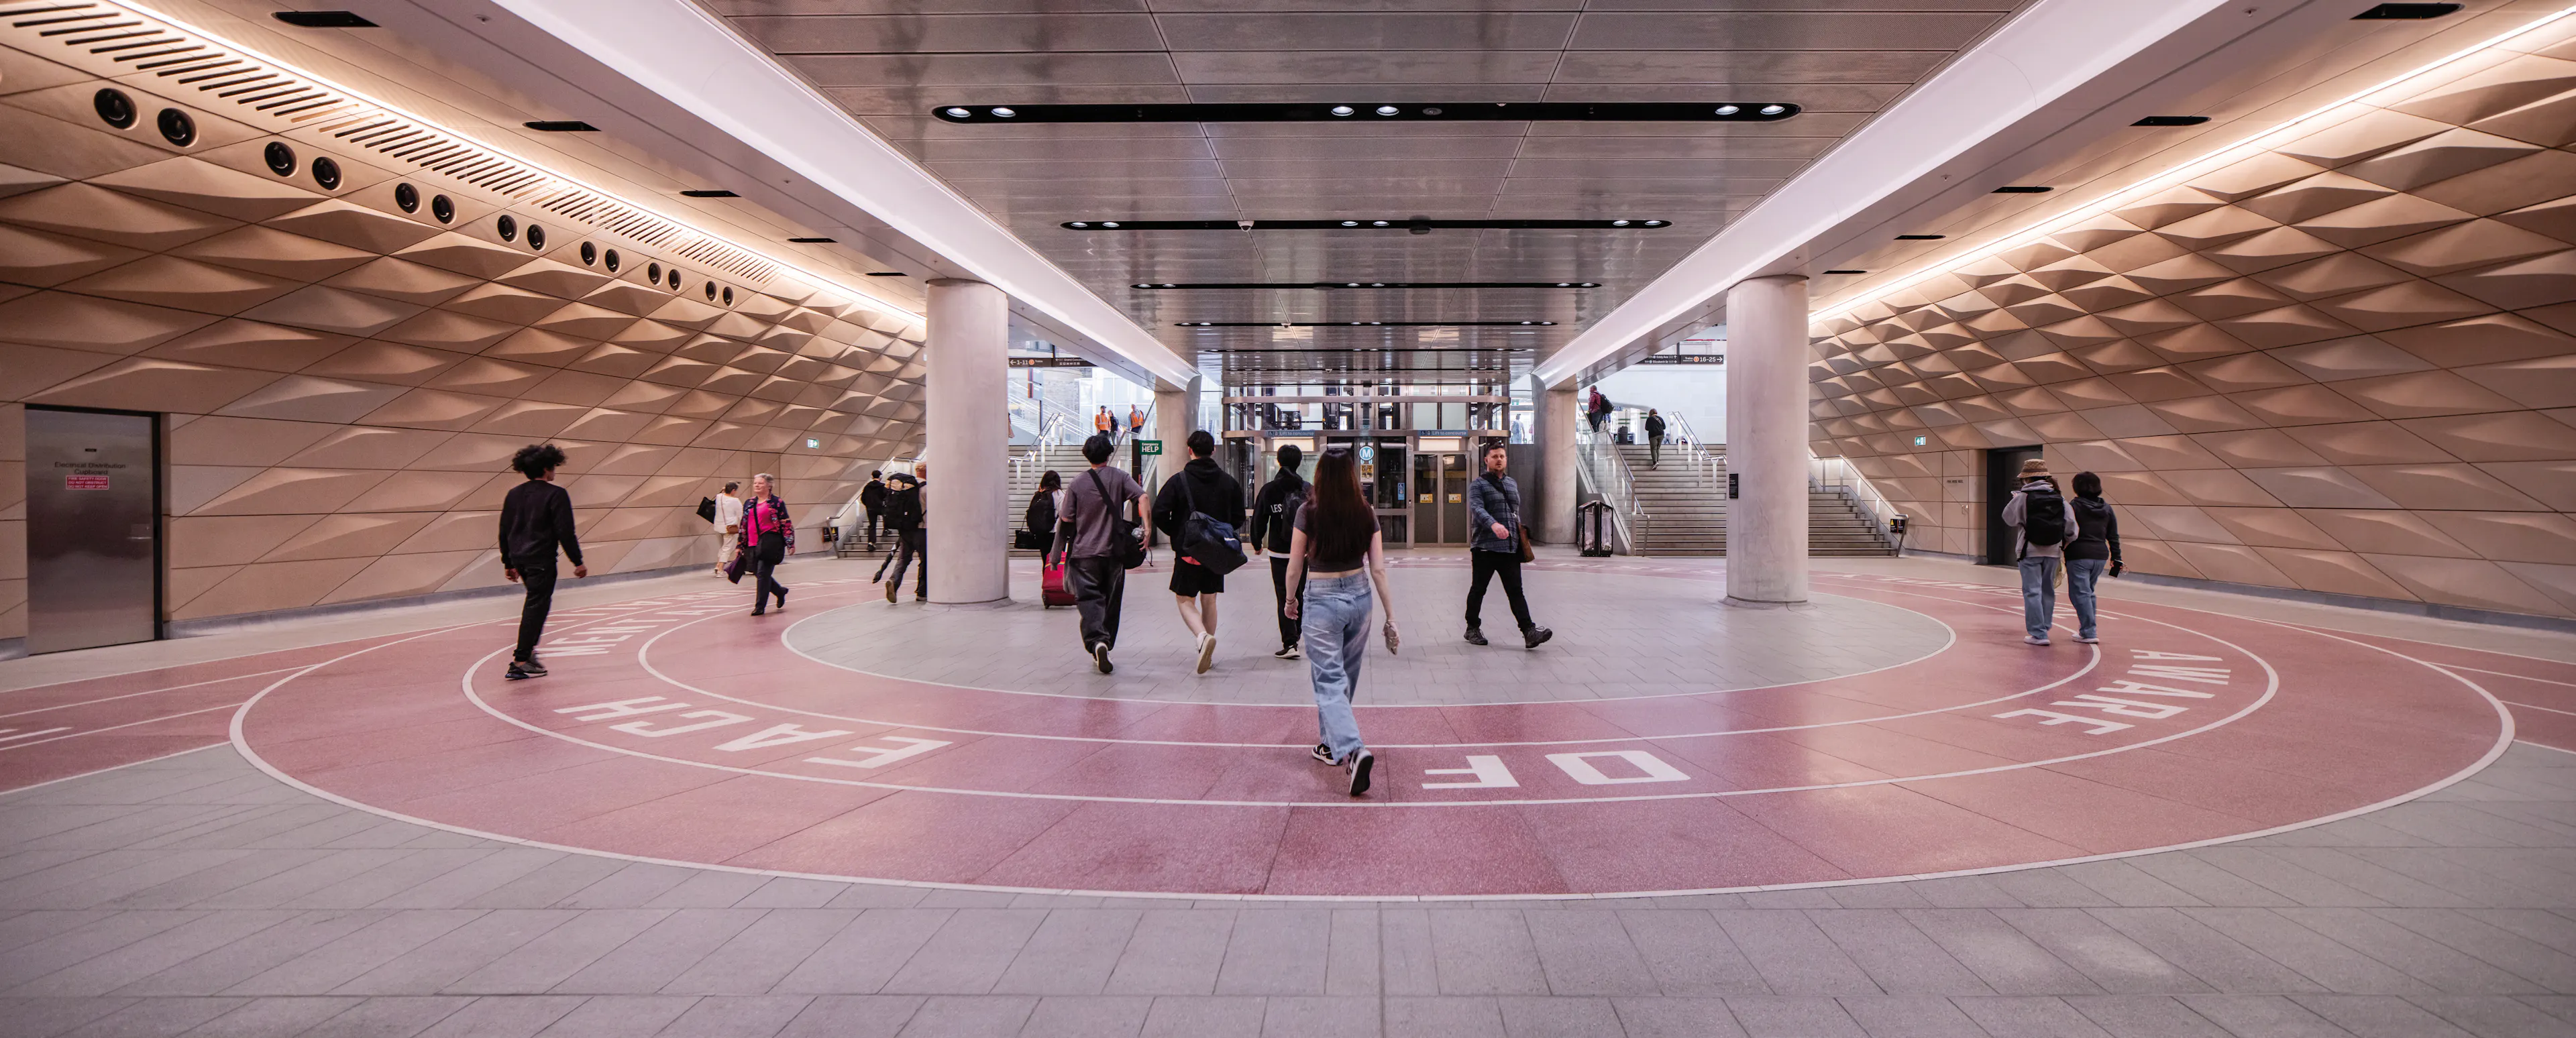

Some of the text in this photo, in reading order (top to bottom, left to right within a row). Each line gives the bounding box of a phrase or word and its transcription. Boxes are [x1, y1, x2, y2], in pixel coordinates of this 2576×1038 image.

[534, 602, 754, 658] MENTAL
[1991, 649, 2231, 735] AWARE
[553, 696, 954, 769] EACH
[1421, 750, 1692, 789] OF
